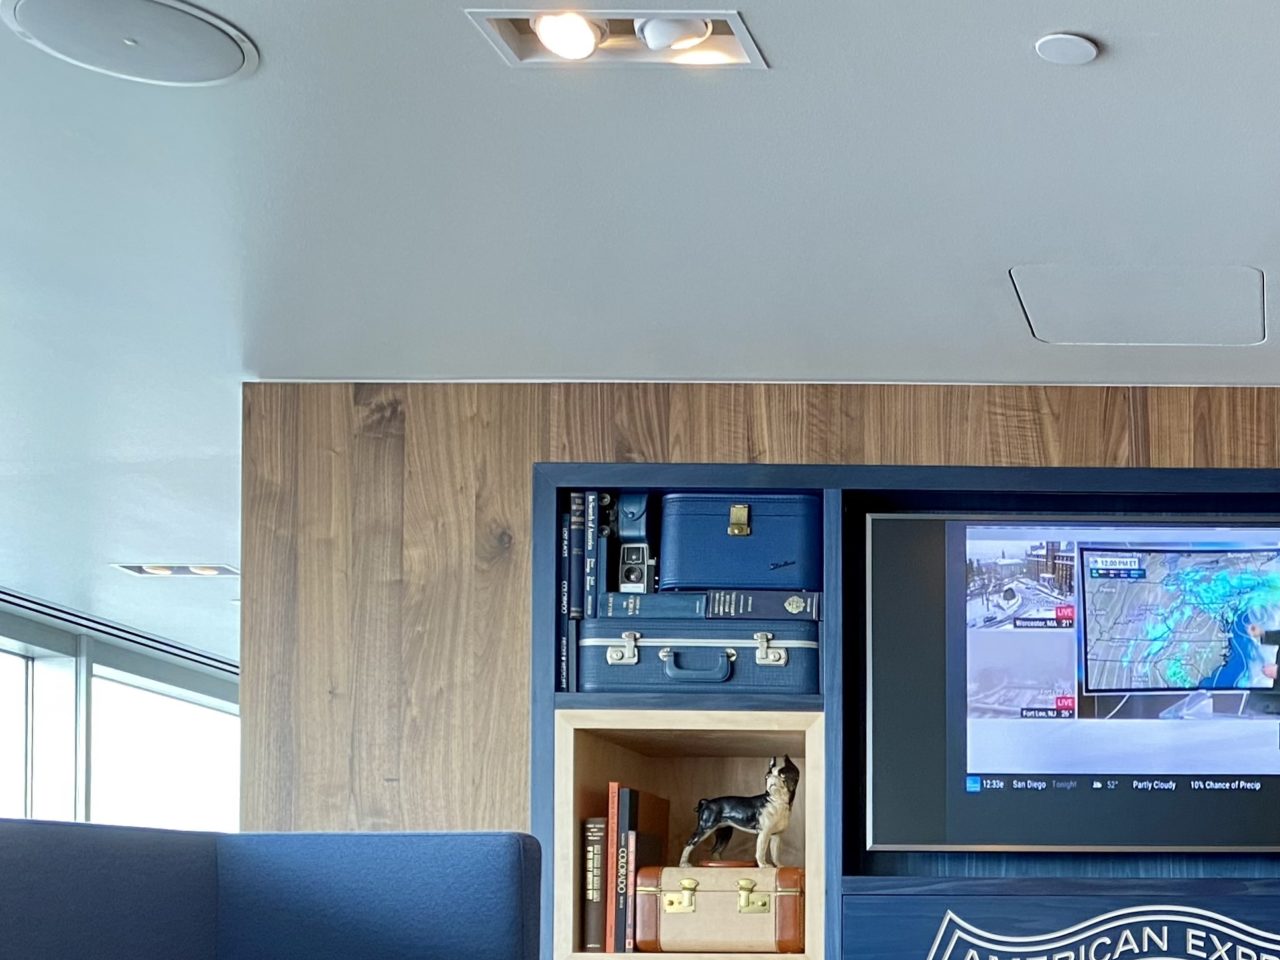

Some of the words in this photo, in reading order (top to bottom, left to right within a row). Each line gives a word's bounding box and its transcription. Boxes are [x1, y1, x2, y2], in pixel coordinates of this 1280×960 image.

[1013, 780, 1025, 789] San
[1027, 780, 1046, 790] Diego
[1052, 780, 1077, 790] Tonight
[1133, 780, 1152, 790] Partly
[1153, 780, 1176, 790] Cloudy
[1191, 780, 1204, 789] 10%
[1205, 780, 1230, 789] Chance
[1231, 780, 1239, 789] of
[1240, 780, 1261, 790] Precip
[618, 848, 627, 893] COLORADO
